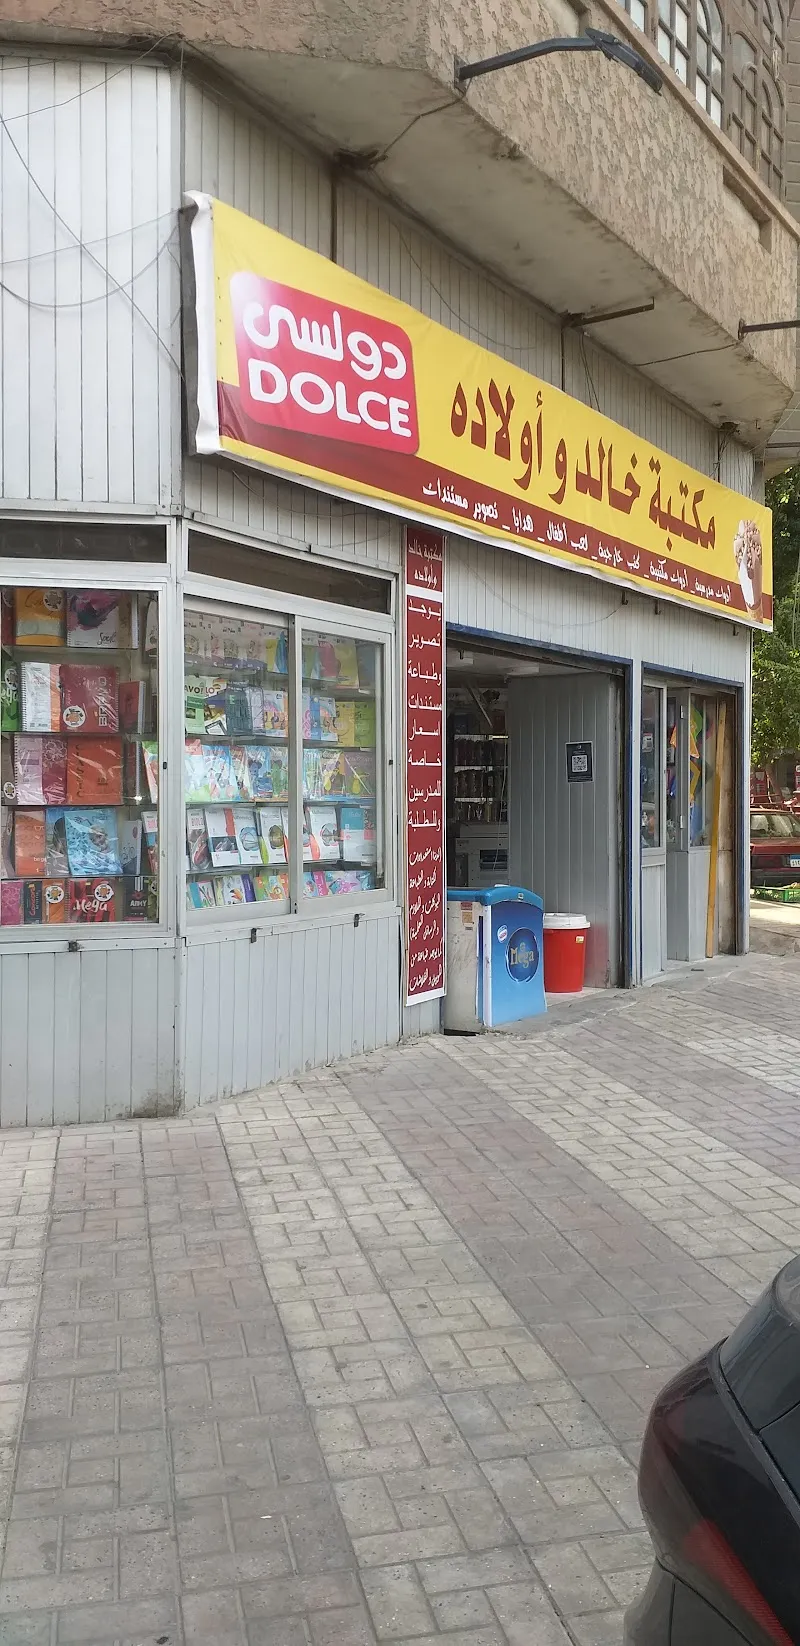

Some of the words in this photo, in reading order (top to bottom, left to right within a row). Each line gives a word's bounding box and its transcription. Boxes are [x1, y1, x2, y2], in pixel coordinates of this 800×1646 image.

[248, 357, 412, 438] DOLCE
[576, 436, 641, 514] خالد
[422, 477, 469, 509] مستندات
[648, 456, 716, 551] مكتبة
[473, 502, 499, 522] تصوير
[512, 507, 534, 533] هدايا
[408, 539, 423, 558] خالد
[424, 544, 443, 562] مكتبة
[571, 534, 588, 551] لعب
[598, 541, 623, 567] خارجية
[627, 550, 640, 569] كتب
[650, 559, 668, 581] مكتبية
[695, 578, 714, 598] مدرسية
[408, 599, 441, 621] يوجد
[408, 632, 441, 649] تصوير
[408, 660, 442, 686] وطباعة
[408, 693, 442, 711] مستندات
[408, 748, 442, 767] خاصة
[408, 780, 442, 802] للمدرسين
[408, 809, 441, 832] وللطلبة
[510, 942, 534, 968] Mega
